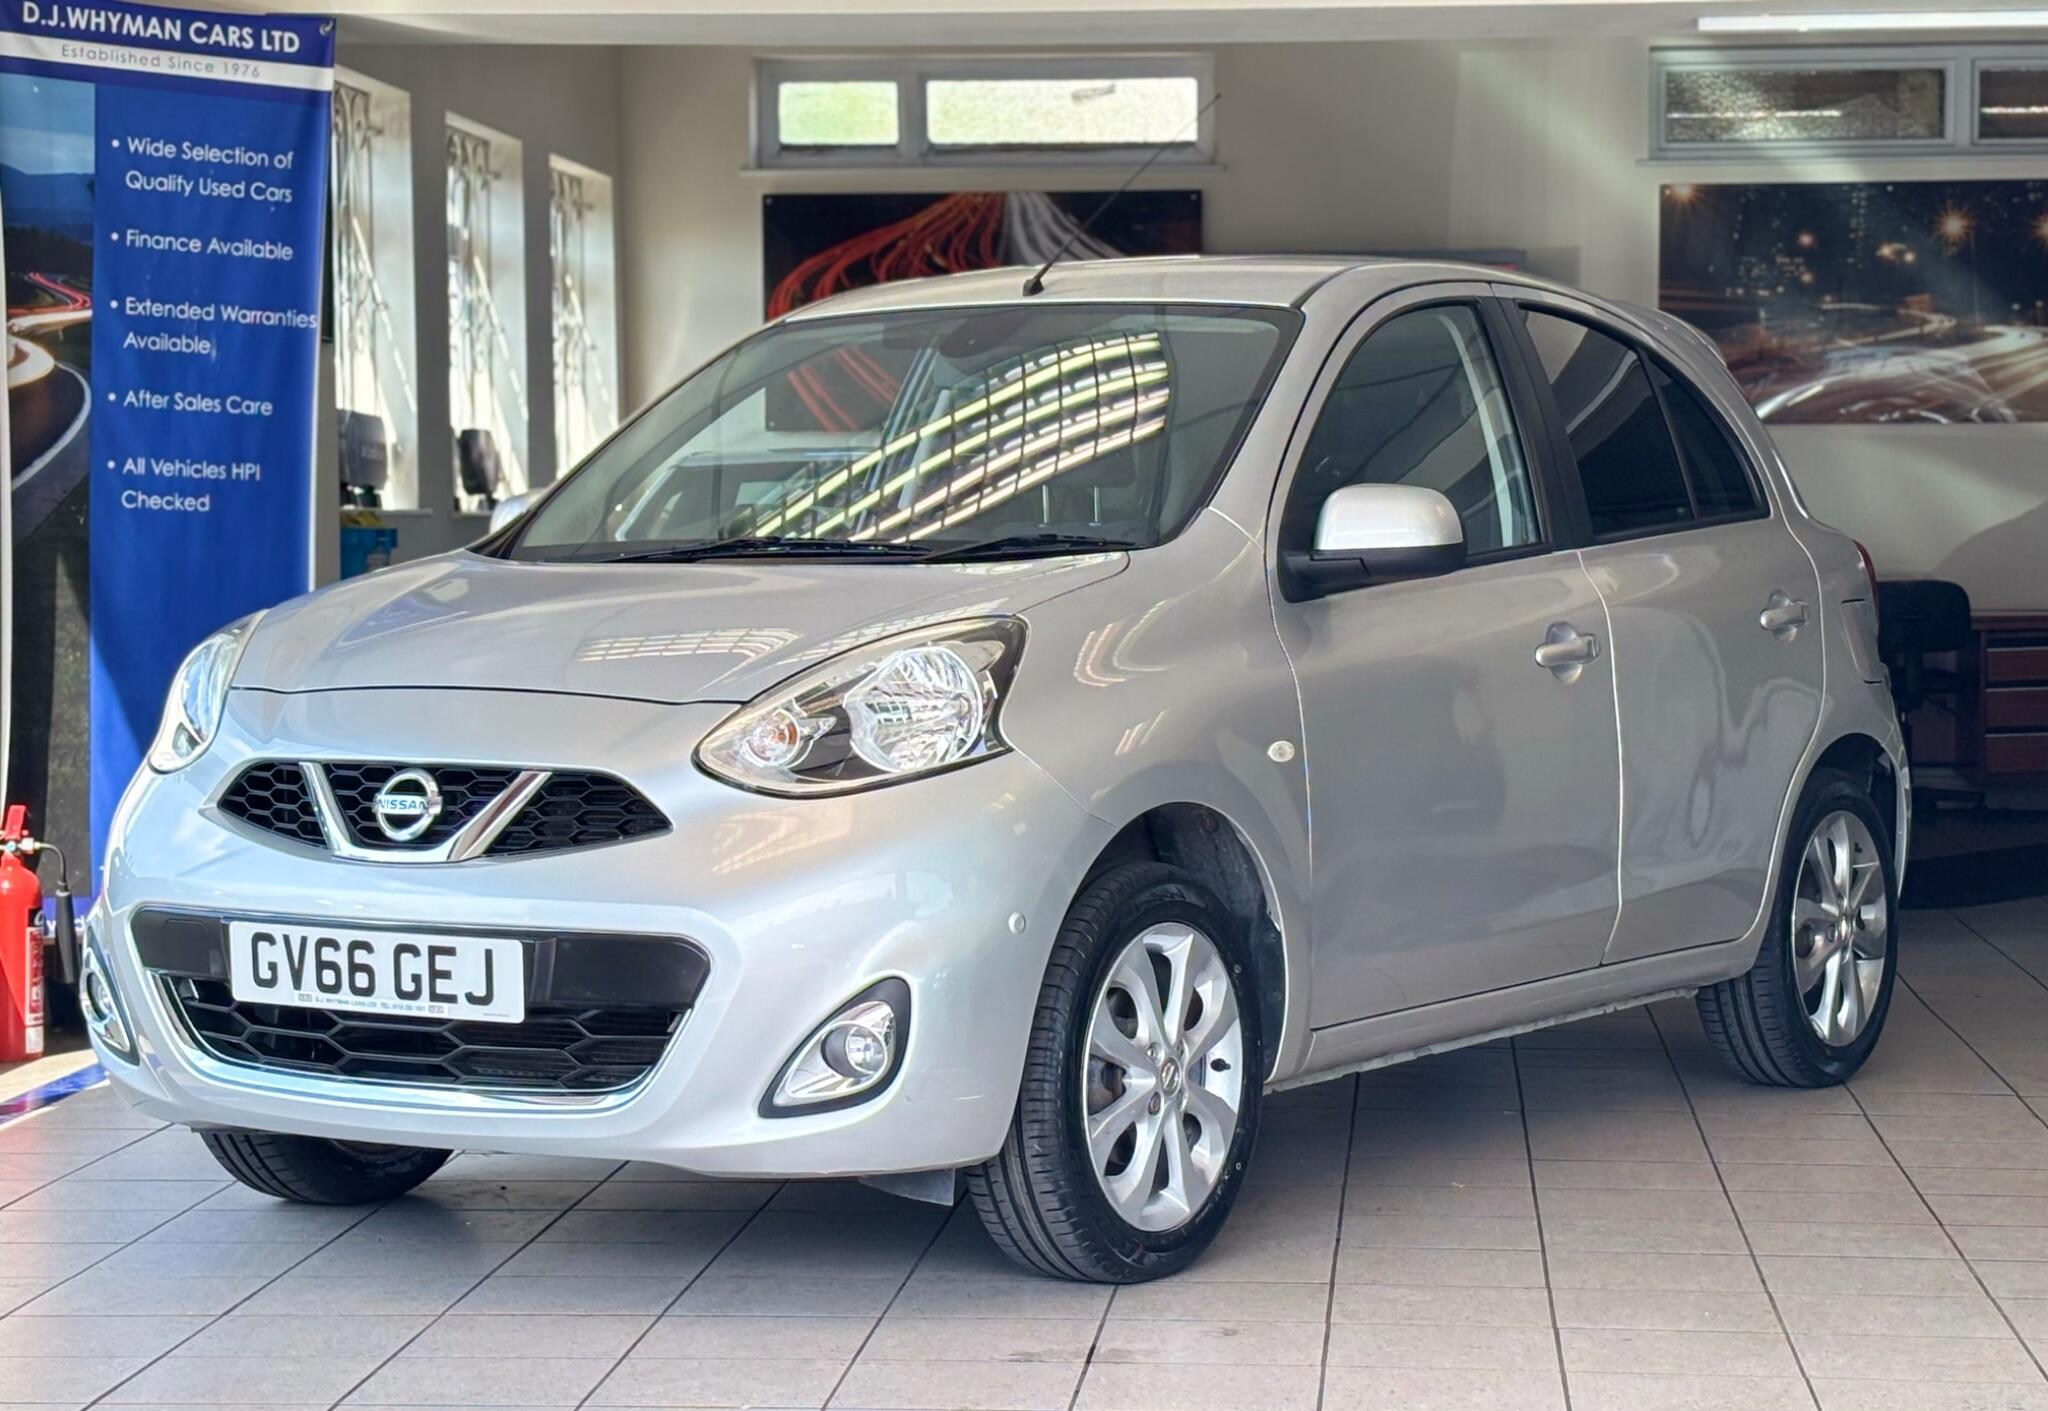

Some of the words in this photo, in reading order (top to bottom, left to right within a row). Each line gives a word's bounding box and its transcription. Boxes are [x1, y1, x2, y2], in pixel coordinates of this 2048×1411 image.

[23, 1, 182, 41] D.J.WHYMAN
[189, 21, 254, 49] CARS
[261, 29, 300, 52] LTD
[61, 45, 161, 67] Established
[168, 55, 214, 73] Since
[223, 62, 261, 78] 1976
[127, 136, 177, 158] Wide
[182, 142, 268, 167] Selection
[273, 151, 294, 170] of
[126, 171, 195, 197] Quality
[199, 177, 245, 198] Used
[250, 182, 293, 203] Cars
[126, 229, 201, 252] Finance
[207, 236, 293, 261] Available
[125, 297, 215, 321] Extended
[221, 305, 318, 328] Warranties
[123, 332, 212, 354] Available
[123, 390, 169, 410] After
[173, 392, 222, 413] Sales
[226, 396, 274, 416] Care
[122, 456, 146, 475] All
[150, 458, 227, 480] Vehicles
[232, 463, 261, 481] HPI
[121, 490, 211, 512] Checked
[378, 798, 428, 811] NISSAN
[251, 931, 376, 998] GV66
[393, 943, 495, 1006] GEJ
